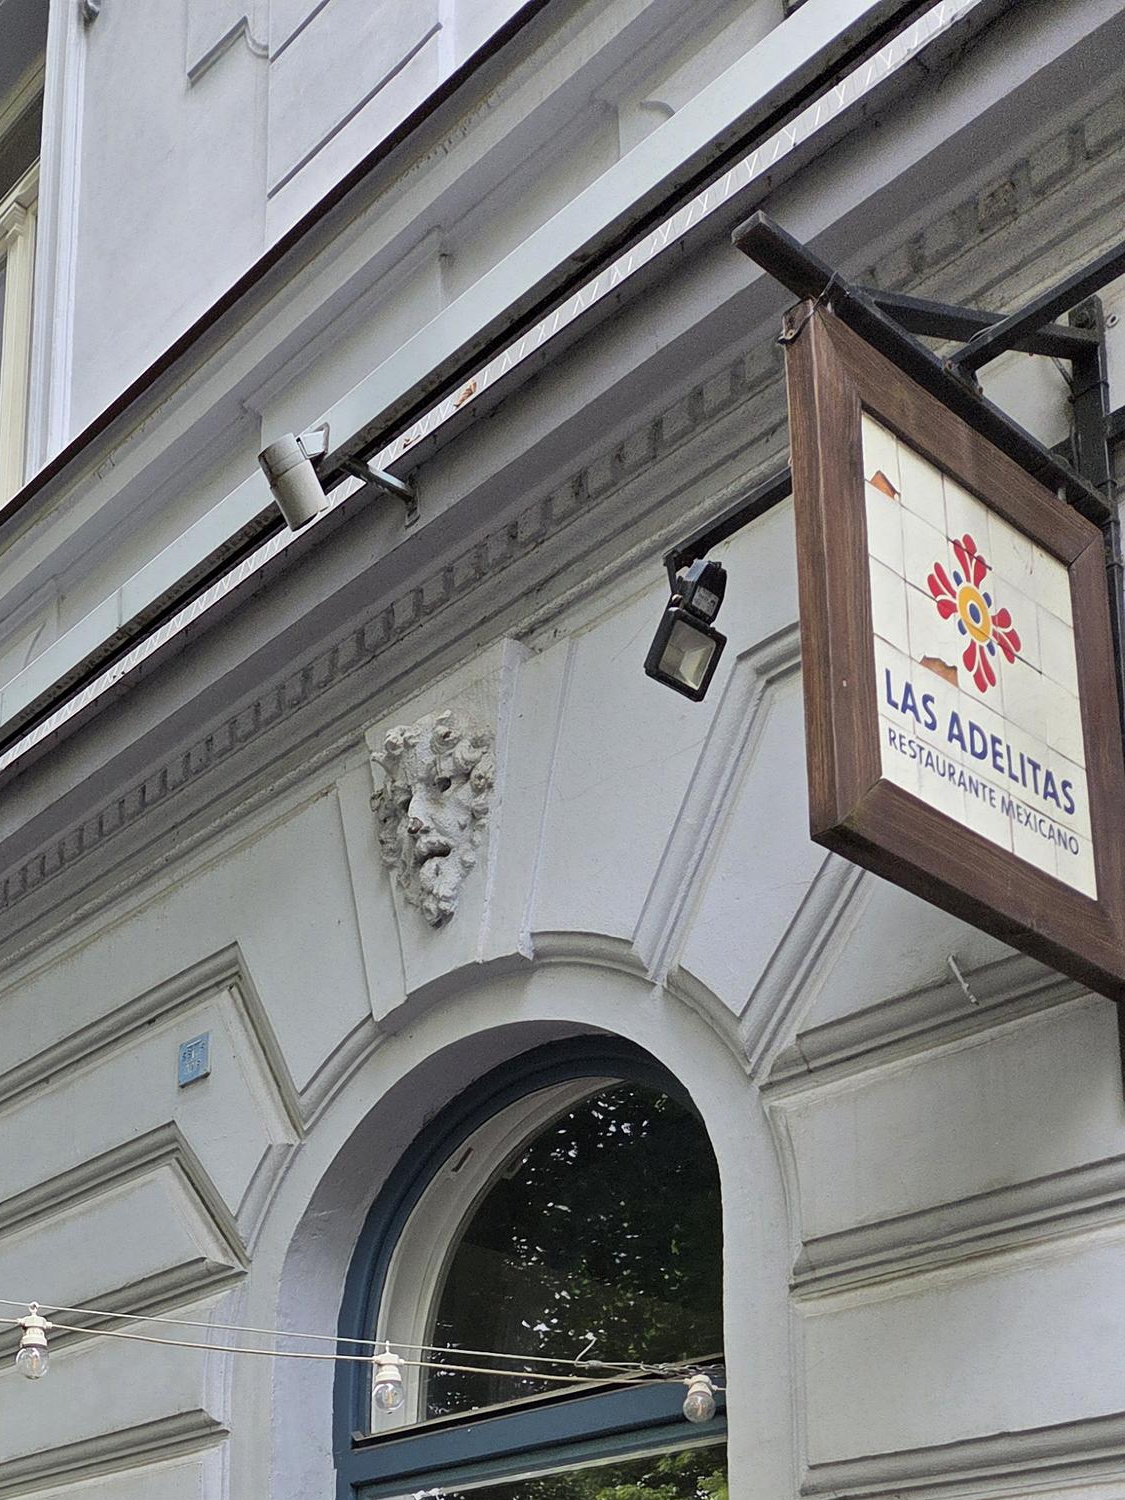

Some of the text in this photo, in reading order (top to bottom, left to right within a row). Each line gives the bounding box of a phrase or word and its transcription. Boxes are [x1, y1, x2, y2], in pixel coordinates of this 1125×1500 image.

[885, 668, 1076, 815] LAS ADELITAS
[888, 728, 1080, 855] RESTAURANTE MEXICANO
